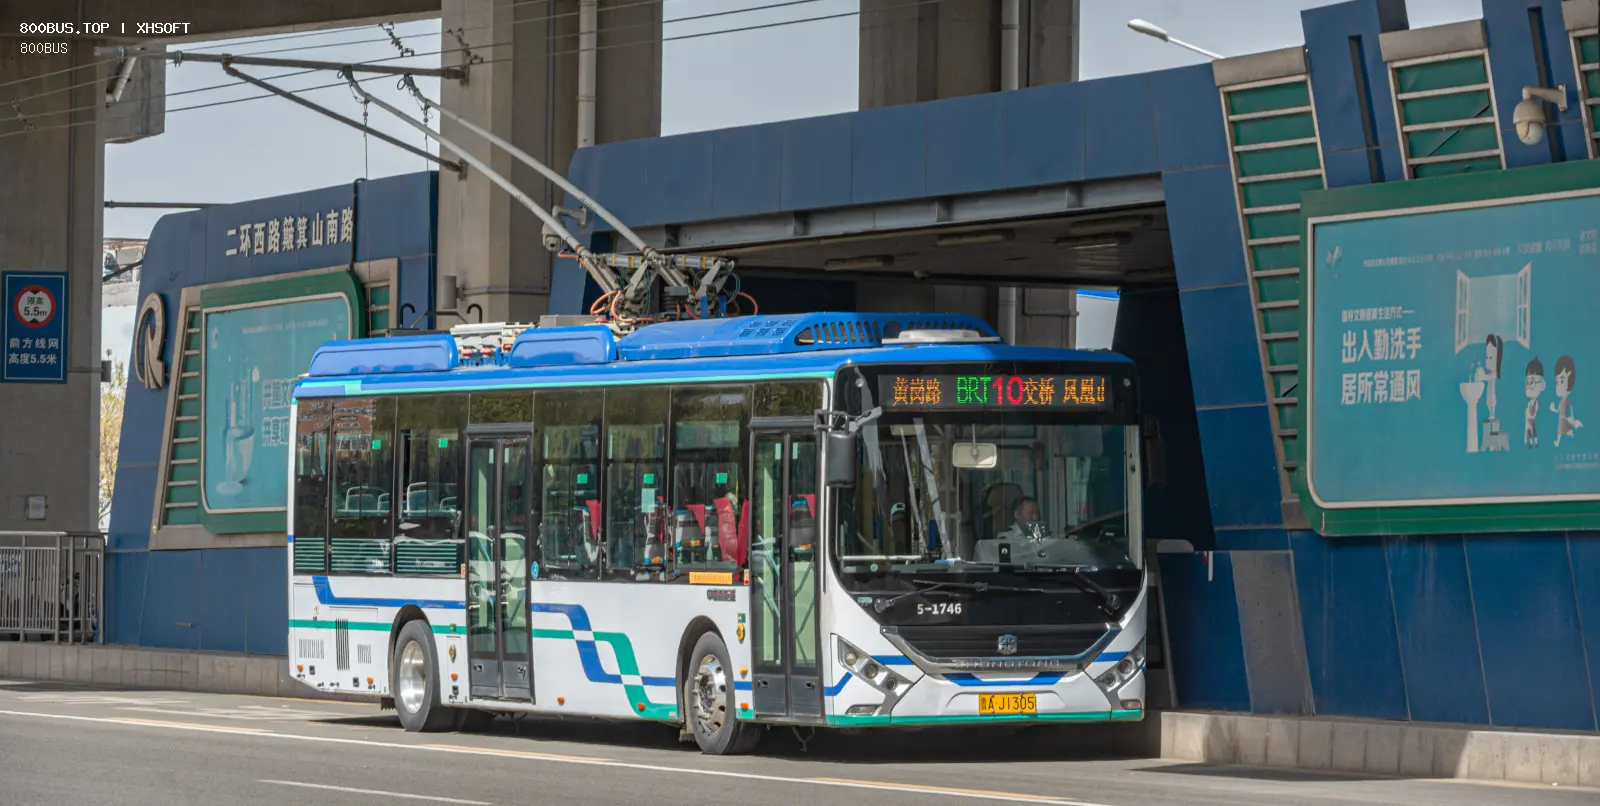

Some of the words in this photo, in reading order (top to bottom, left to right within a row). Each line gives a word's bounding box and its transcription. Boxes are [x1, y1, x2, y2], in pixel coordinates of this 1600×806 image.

[27, 297, 44, 305] 限高
[24, 306, 48, 316] 5.5m
[9, 337, 59, 349] 前方线网
[1341, 326, 1422, 364] 出入勤洗手
[8, 353, 57, 365] 高度5.5米
[893, 376, 942, 407] 黄岗路
[1341, 369, 1422, 405] 居所常通风
[917, 603, 962, 615] 5-1746
